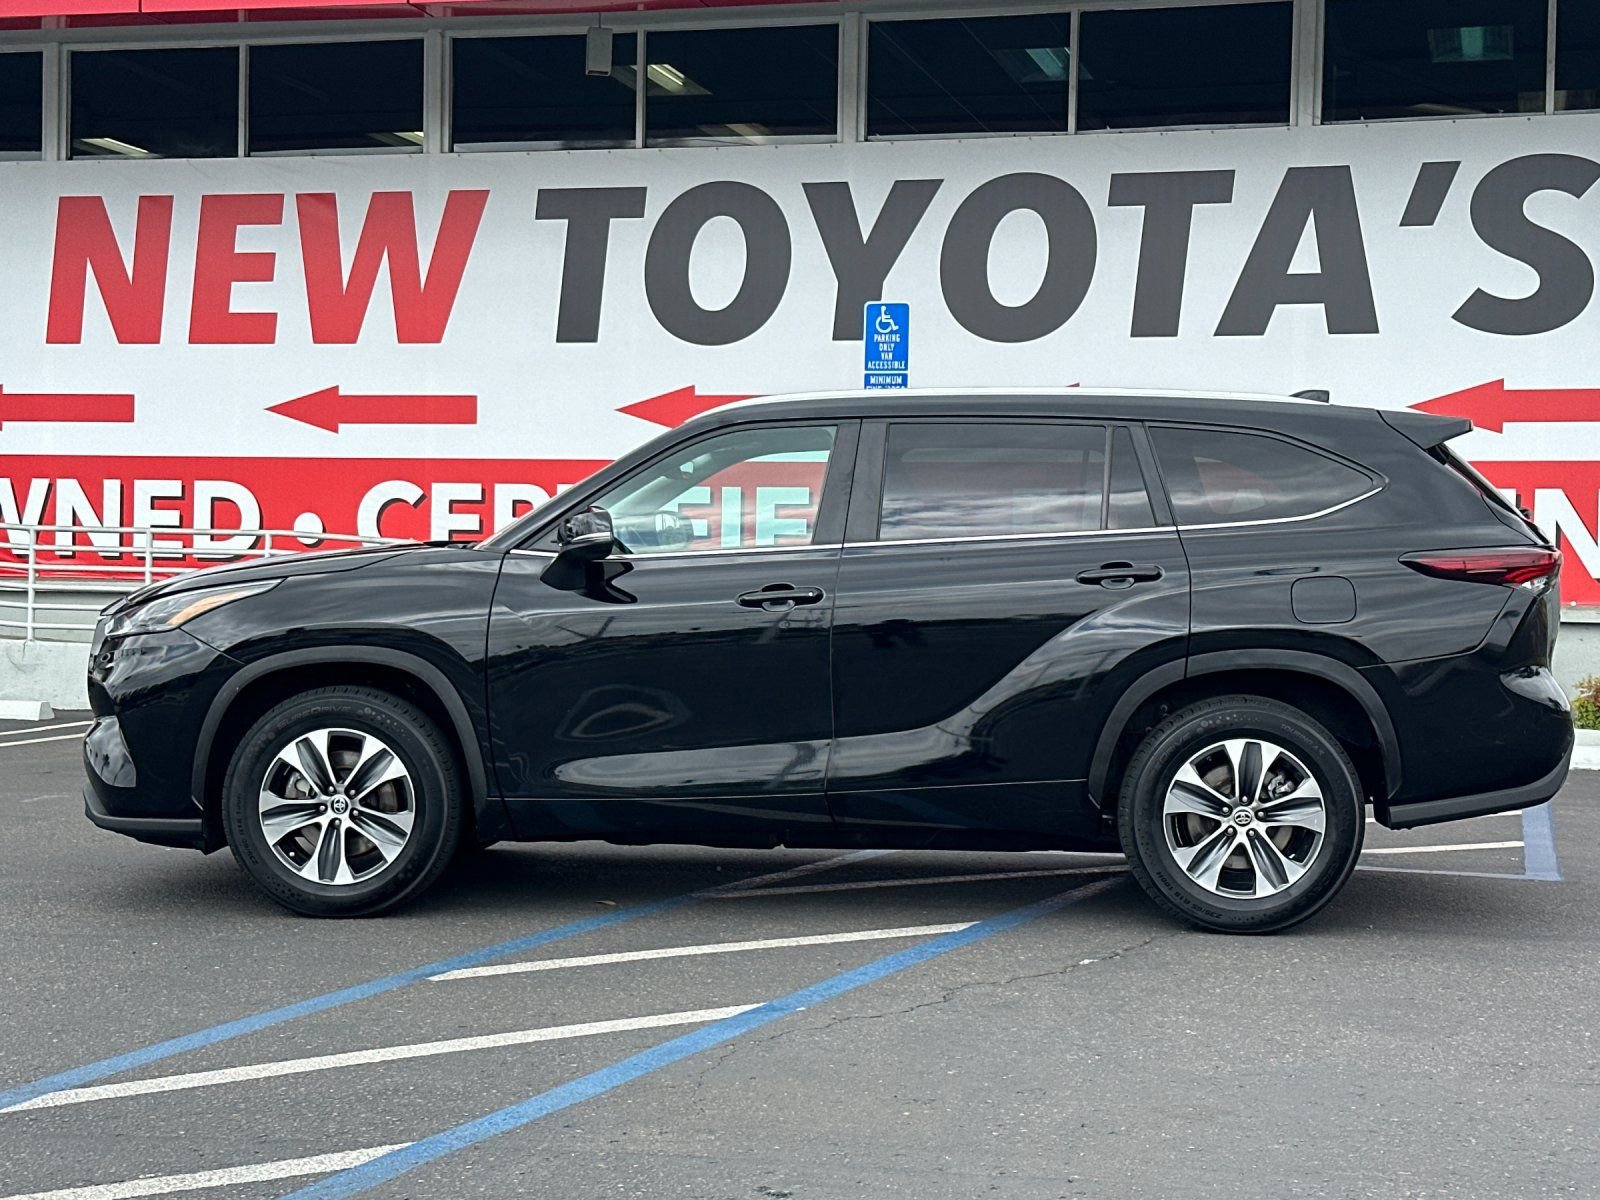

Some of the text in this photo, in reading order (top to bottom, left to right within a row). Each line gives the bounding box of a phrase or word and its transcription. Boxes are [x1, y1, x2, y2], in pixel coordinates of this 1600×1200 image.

[46, 153, 1600, 346] NEW TOYOTA'S
[873, 333, 901, 343] PARKING
[879, 343, 895, 351] ONLY
[881, 352, 893, 360] VAN
[867, 360, 906, 369] ACCESSIBLE
[869, 375, 903, 385] MINIMUM
